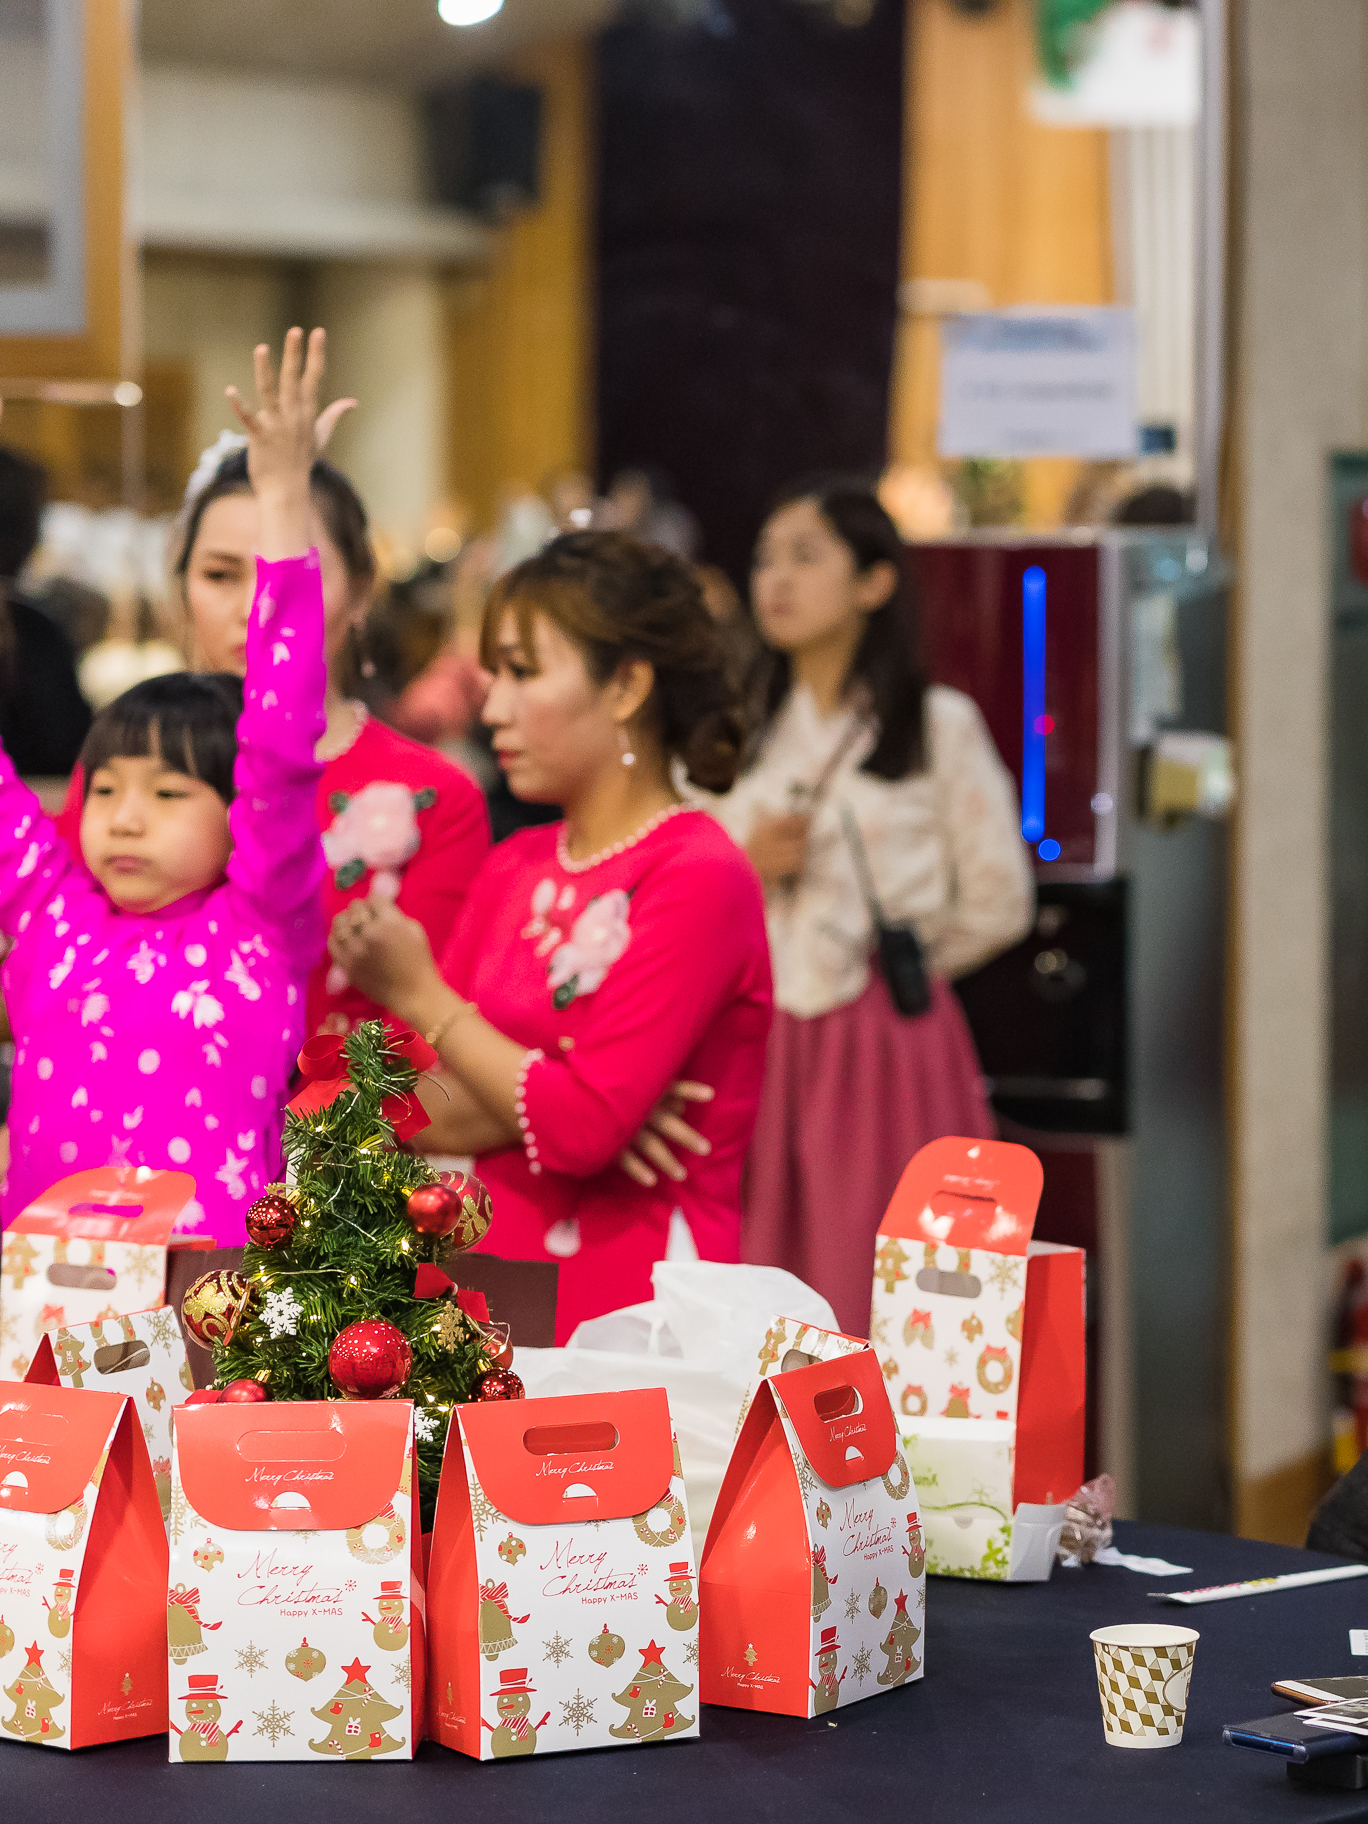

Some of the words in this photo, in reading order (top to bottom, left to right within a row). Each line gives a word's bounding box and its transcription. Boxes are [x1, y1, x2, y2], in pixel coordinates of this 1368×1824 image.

[829, 1427, 845, 1443] Merry
[245, 1466, 283, 1485] Merry
[283, 1469, 334, 1481] Christmas
[535, 1460, 568, 1478] Merry
[568, 1459, 614, 1473] Christmas
[839, 1498, 874, 1531] Merry
[843, 1524, 893, 1556] Christmas
[539, 1538, 608, 1574] Merry
[864, 1552, 878, 1561] Happy
[878, 1545, 894, 1557] X-MAS
[237, 1548, 314, 1586] Merry
[10, 1586, 31, 1597] X-MAS
[542, 1569, 638, 1596] Christmas
[237, 1582, 344, 1606] Christmas
[581, 1597, 607, 1606] Happy
[610, 1592, 638, 1602] X-MAS
[280, 1608, 309, 1618] Happy
[312, 1608, 343, 1616] X-MAS
[720, 1666, 745, 1682] Merry
